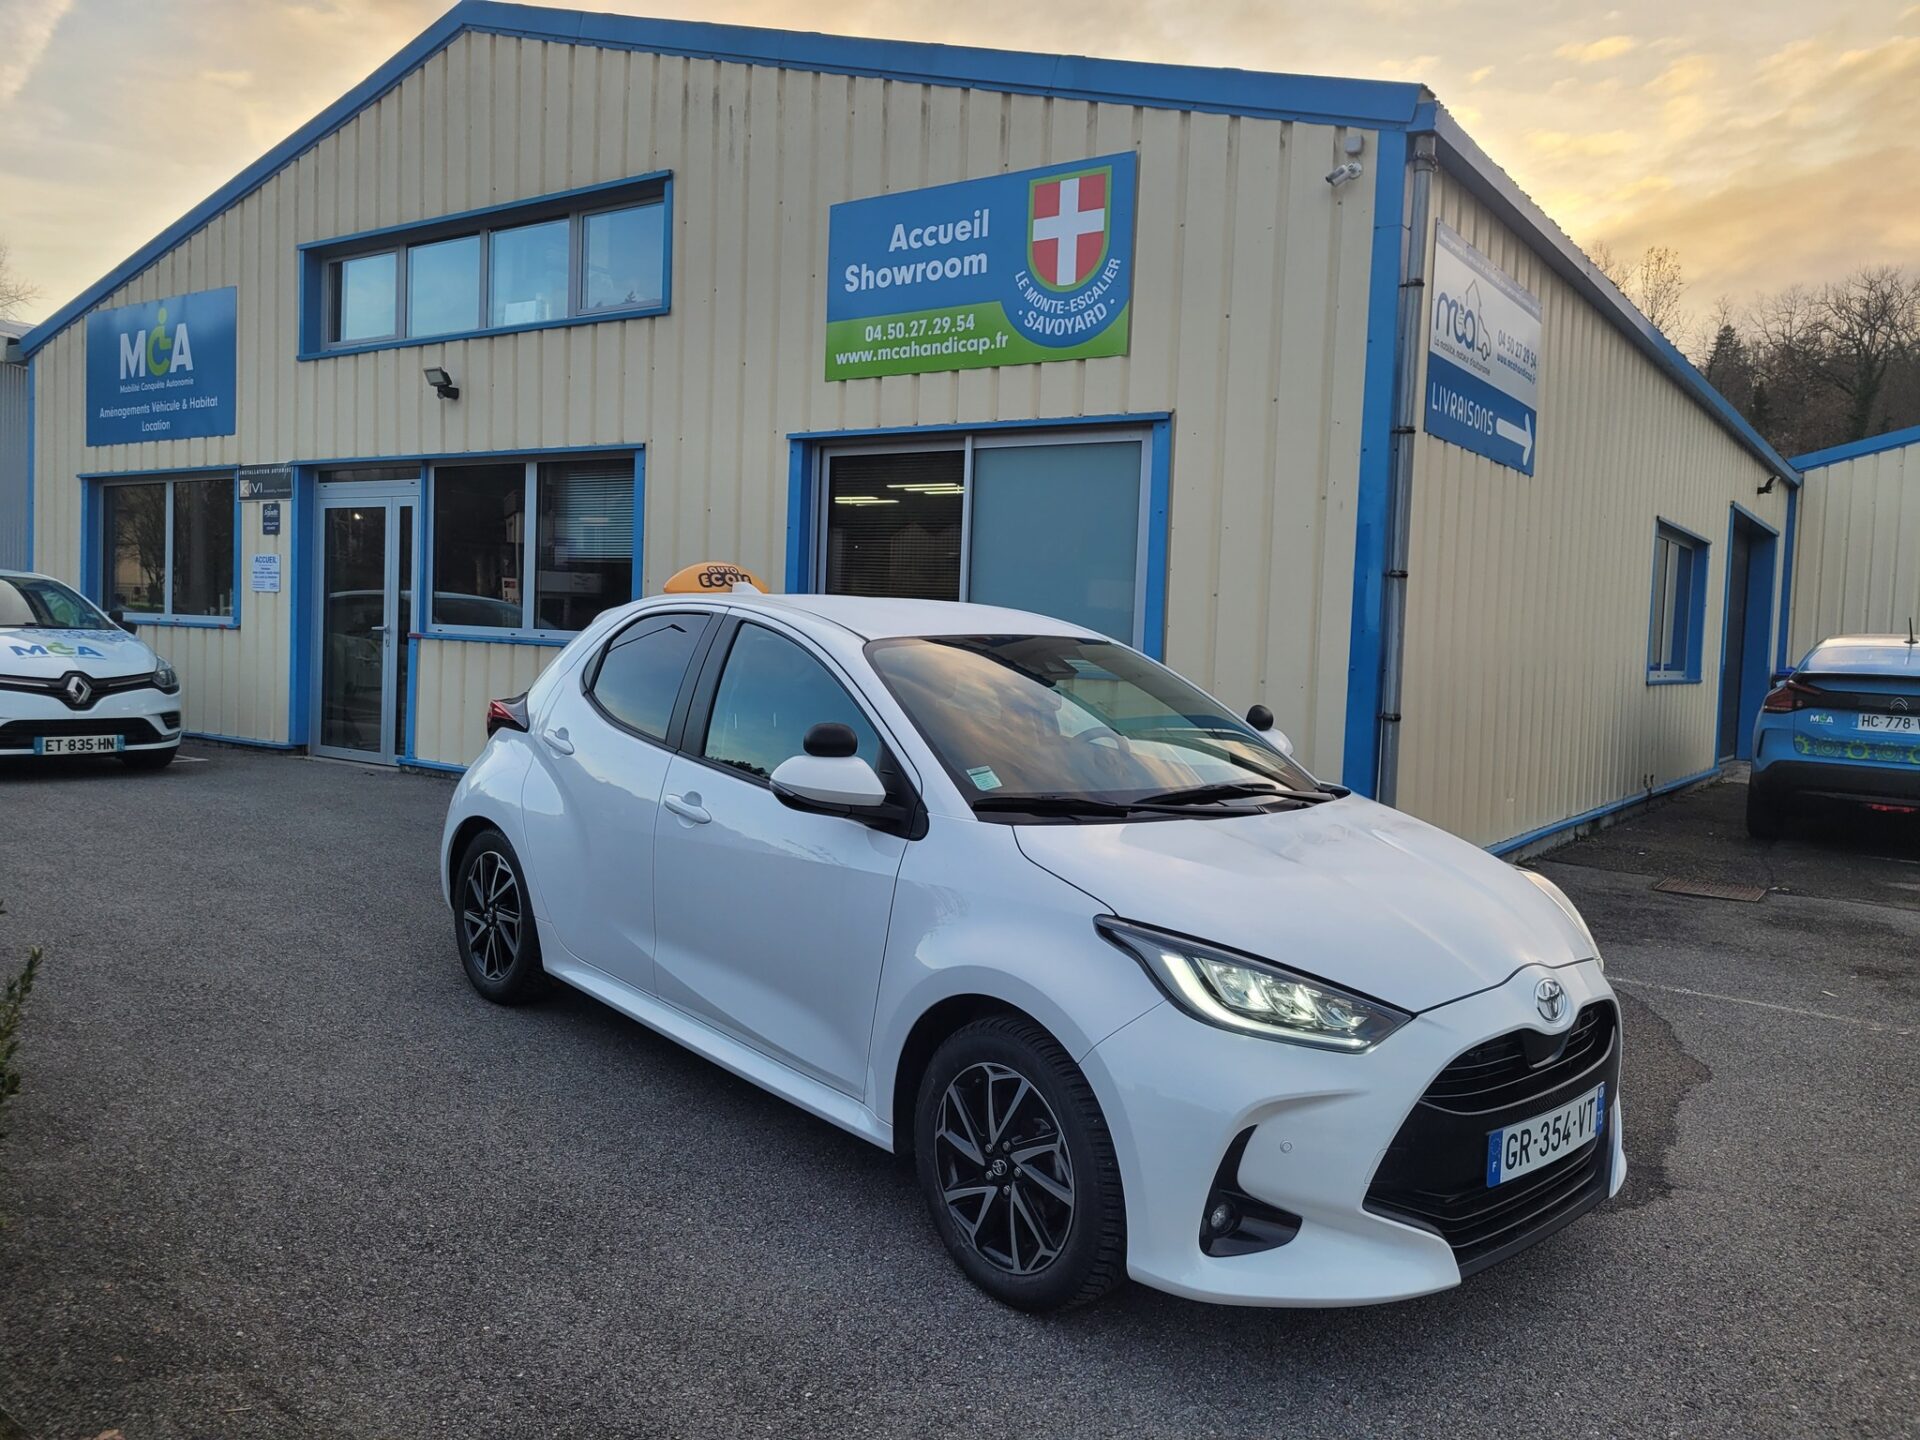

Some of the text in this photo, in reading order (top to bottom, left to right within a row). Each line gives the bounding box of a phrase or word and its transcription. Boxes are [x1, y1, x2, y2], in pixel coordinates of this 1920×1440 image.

[888, 208, 990, 252] Accueil
[845, 252, 988, 293] Showroom
[1014, 257, 1121, 315] LE MONTE-ESCALIER
[865, 313, 976, 342] 04.50.27.29.54
[1023, 302, 1107, 336] SAVOYARD
[120, 322, 194, 380] MCA
[835, 331, 1009, 365] www.mcahandicap.fr
[100, 395, 218, 419] Aménagements Véhicule & Habitat
[1432, 381, 1494, 436] LIVRAISONS
[142, 419, 171, 432] Location
[708, 566, 738, 574] AUTO
[9, 641, 105, 657] MCA
[1861, 714, 1920, 730] HC-778-
[45, 738, 114, 752] ET-835-HN
[1505, 1097, 1596, 1170] GR-354-VT
